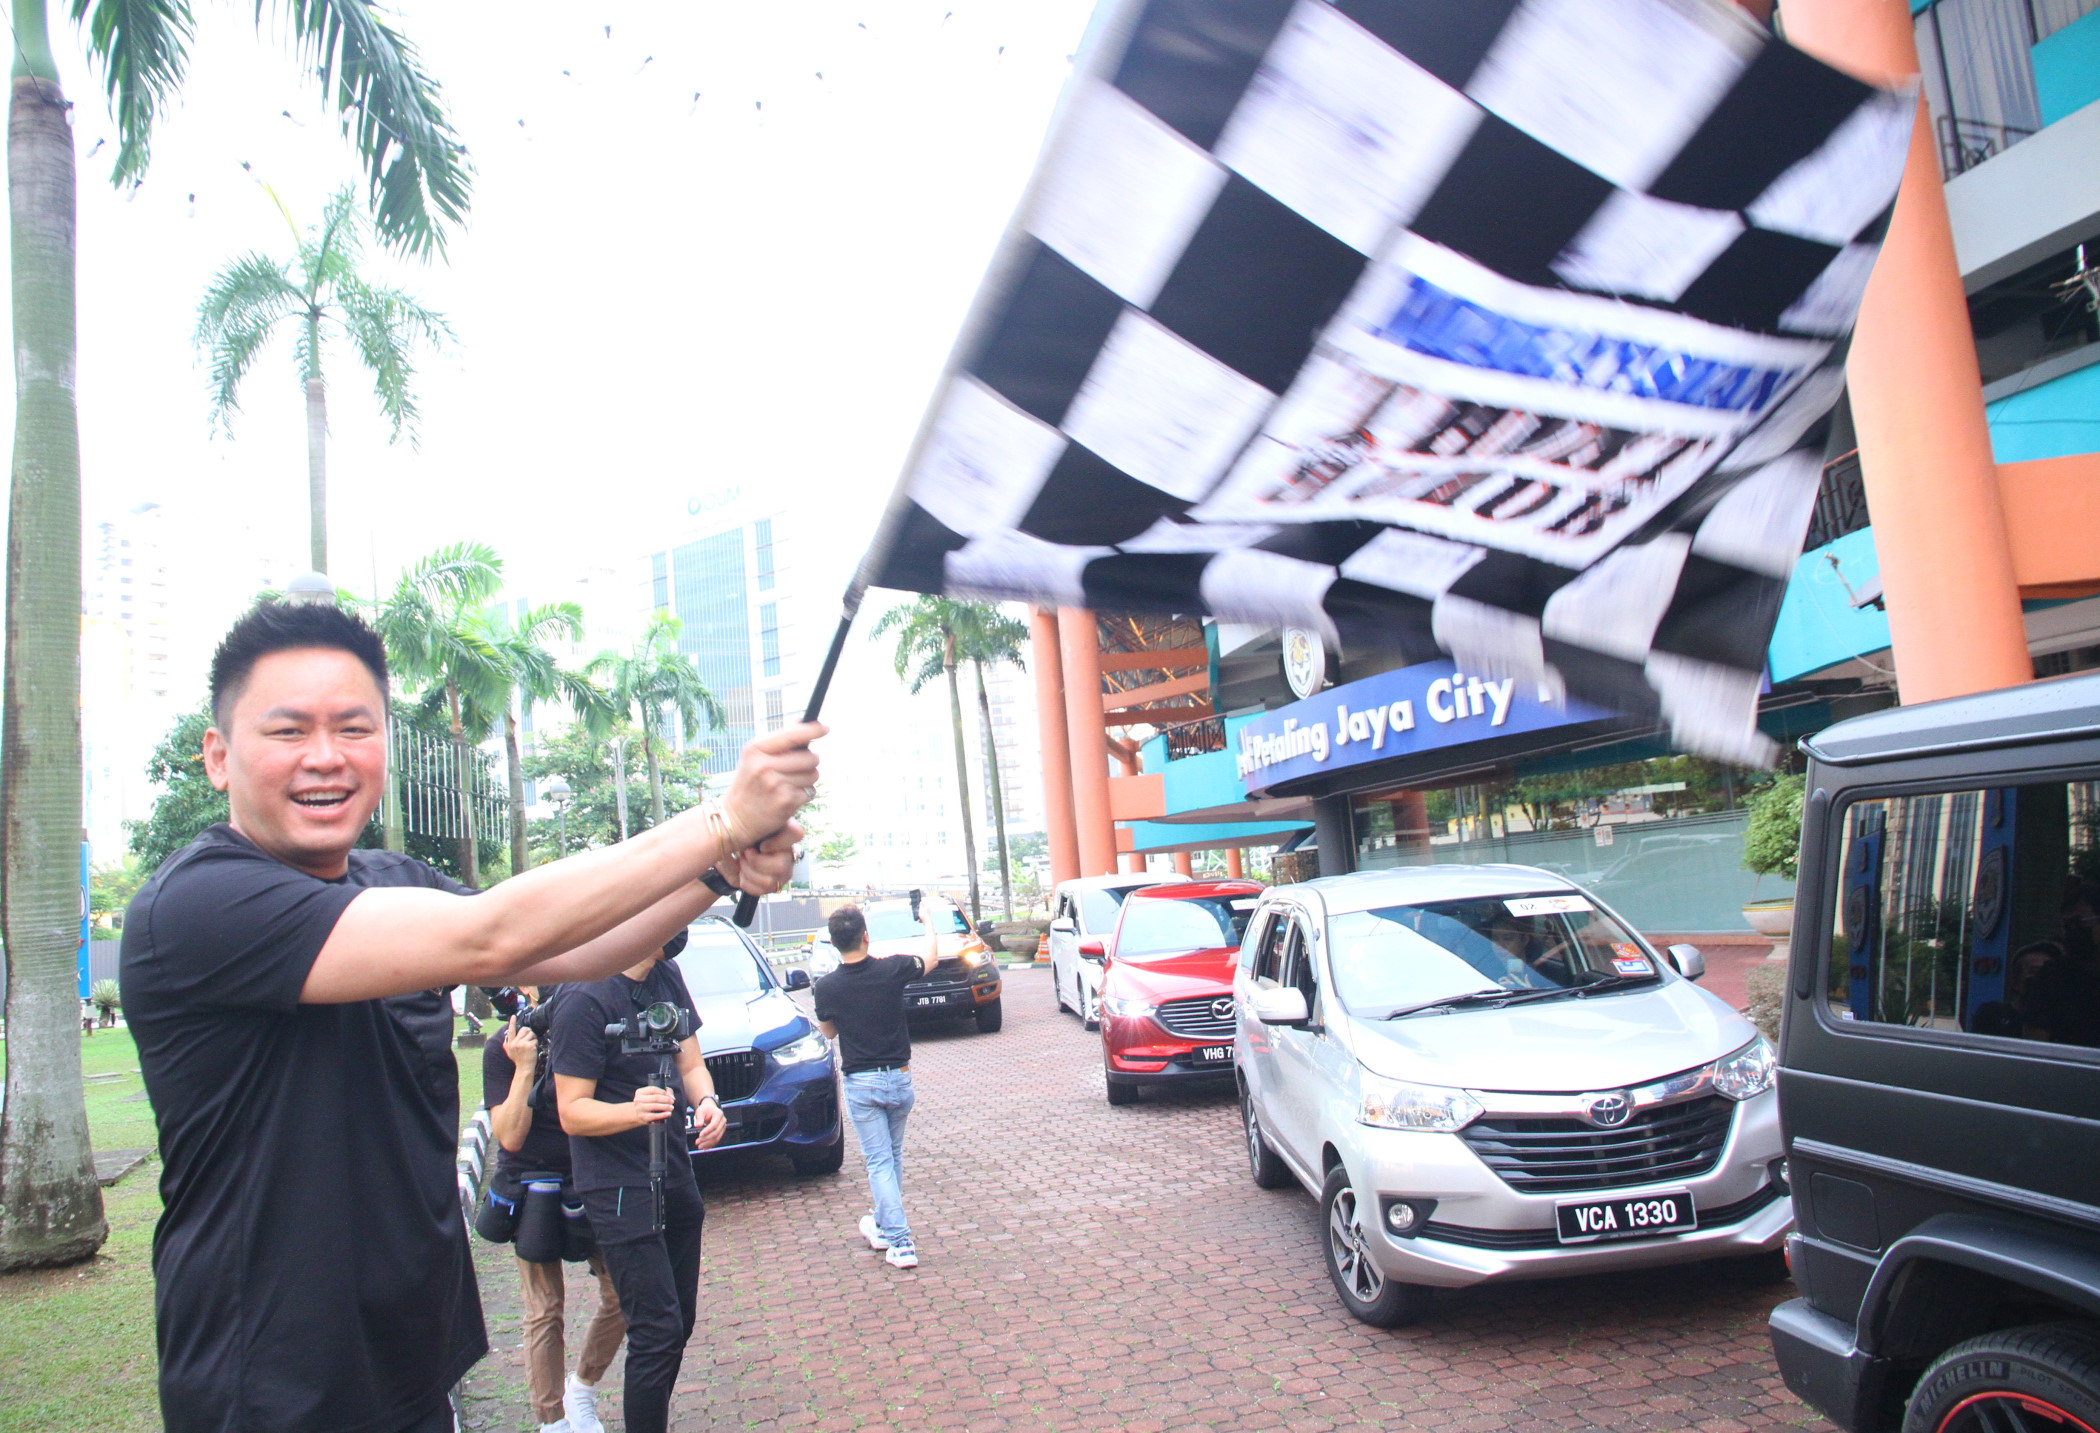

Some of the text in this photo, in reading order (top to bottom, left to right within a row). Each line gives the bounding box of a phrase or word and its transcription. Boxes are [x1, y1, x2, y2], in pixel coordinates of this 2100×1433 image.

[1253, 718, 1329, 769] Petaling
[1335, 700, 1415, 750] Jaya
[1427, 673, 1514, 726] City
[917, 997, 930, 1005] JTB
[1203, 1045, 1235, 1060] VHG 7
[1575, 1199, 1677, 1231] VCA 1330
[1920, 1361, 2004, 1413] MICHELIN
[2020, 1367, 2053, 1385] PILOT
